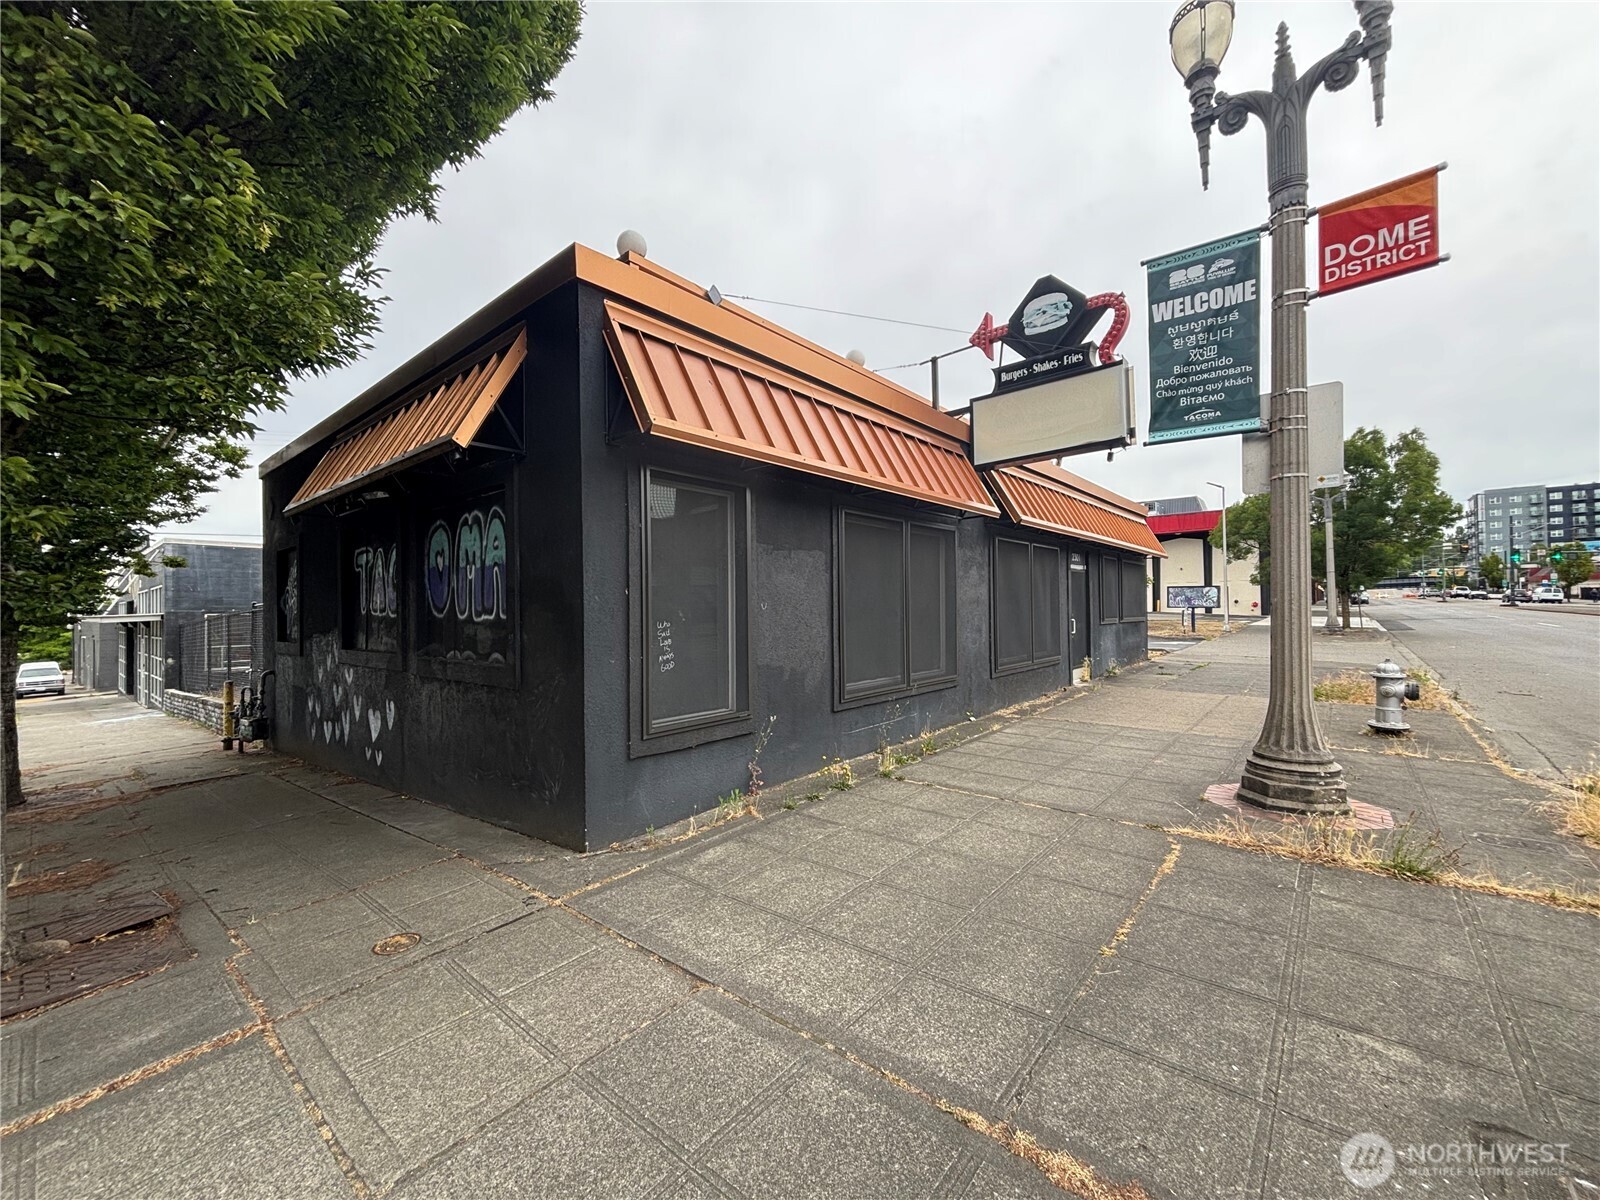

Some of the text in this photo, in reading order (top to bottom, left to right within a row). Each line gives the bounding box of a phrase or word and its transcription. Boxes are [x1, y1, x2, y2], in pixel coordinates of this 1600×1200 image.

[1324, 214, 1431, 267] DOME
[1324, 239, 1431, 283] DISTRICT
[1152, 279, 1257, 323] WELCOME
[1173, 327, 1234, 349] 환영합니다
[1189, 345, 1218, 361] 欢迎
[1001, 352, 1084, 382] Burgers Shakes Fries
[1156, 365, 1253, 389] Добро пожаловать
[1173, 356, 1233, 375] Bienvenido
[1156, 389, 1177, 398] Chào
[1205, 380, 1223, 392] quý
[1225, 375, 1253, 388] khách
[1184, 411, 1221, 421] TACOMA
